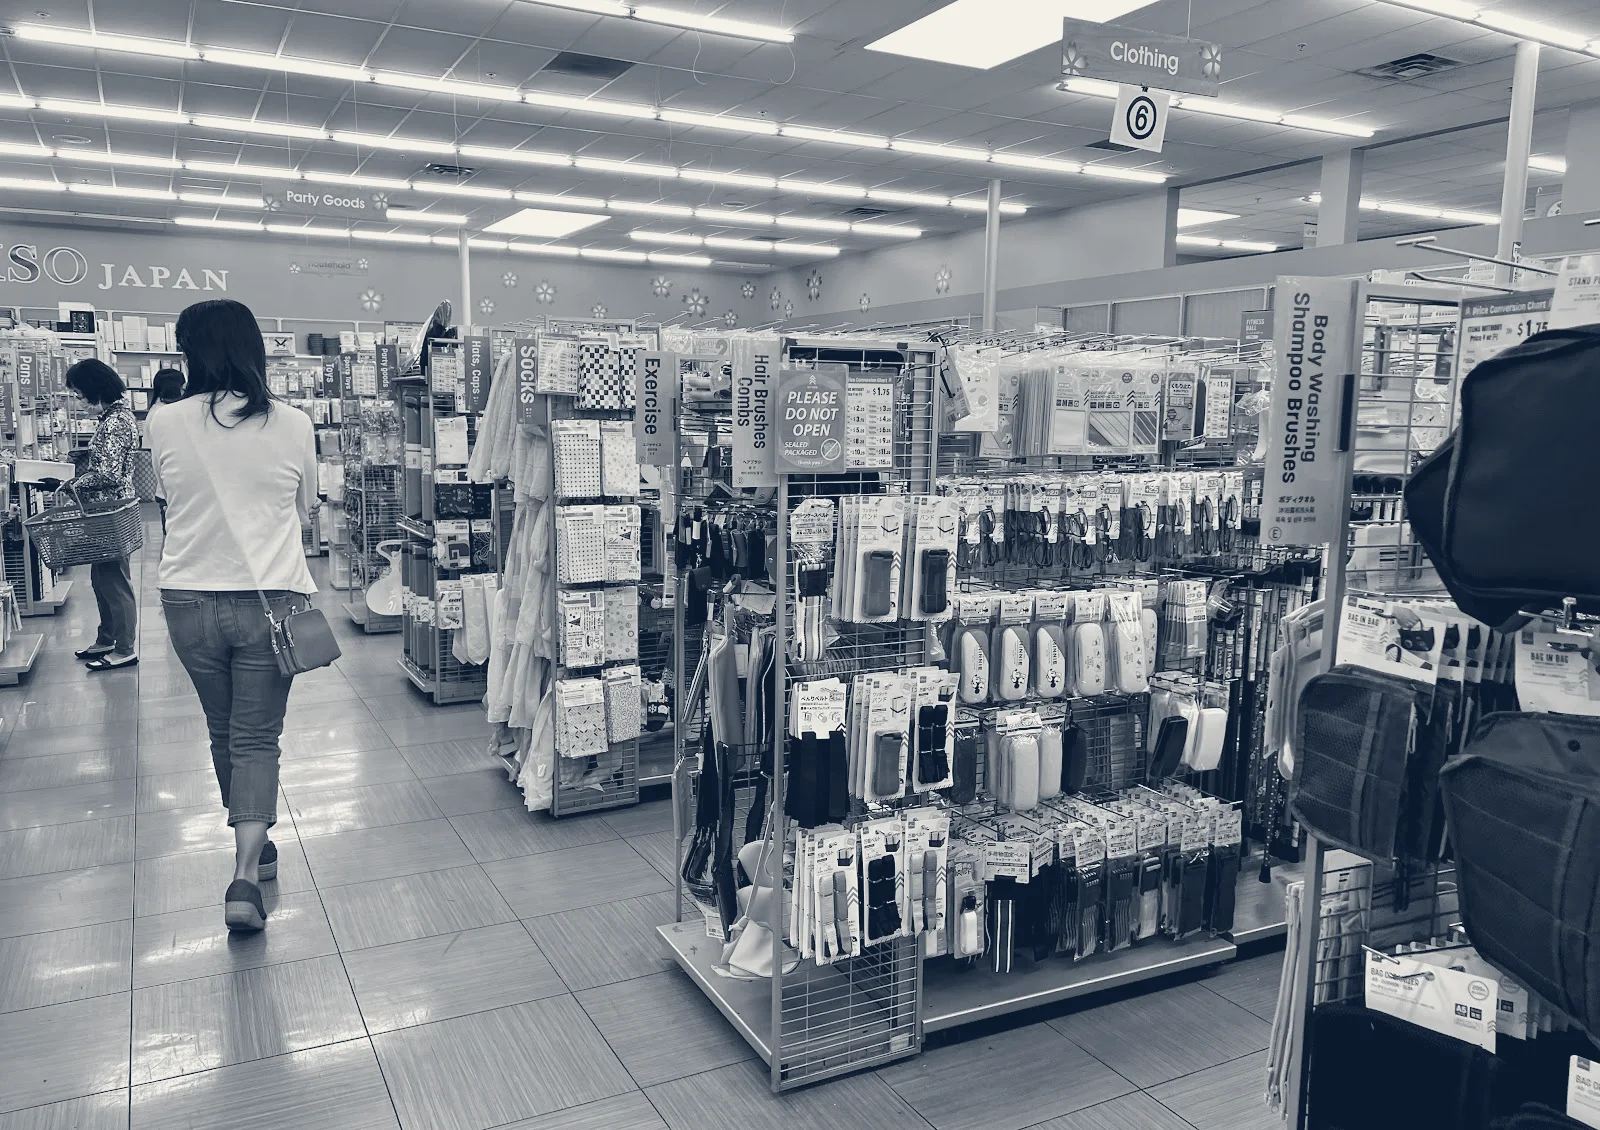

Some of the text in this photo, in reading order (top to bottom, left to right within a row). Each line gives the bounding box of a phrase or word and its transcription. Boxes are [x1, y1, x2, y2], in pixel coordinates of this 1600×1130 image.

[1110, 41, 1179, 76] Clothing
[1135, 105, 1149, 131] 6
[286, 190, 366, 209] Party Goods
[0, 244, 229, 291] SO JAPAN
[1472, 306, 1488, 316] Price
[1490, 302, 1526, 313] Conversion
[1286, 292, 1310, 391] Shampoo
[20, 356, 32, 385] Pans
[325, 363, 335, 383] Toys
[380, 348, 389, 388] Party goods
[470, 341, 481, 394] Hats, Caps
[344, 376, 352, 390] Toys
[1301, 315, 1328, 462] Body Washing
[645, 359, 661, 435] Exercise
[737, 377, 753, 427] Combs
[754, 355, 769, 449] Hair Brushes
[787, 391, 837, 404] PLEASE
[785, 408, 839, 420] DO NOT
[793, 424, 831, 436] OPEN
[1282, 398, 1302, 483] Brushes
[1348, 612, 1358, 621] BAG
[1368, 617, 1380, 626] BAG
[1531, 652, 1569, 664] BAG IN BAG
[1371, 968, 1384, 978] BAG
[1576, 1075, 1591, 1087] BAG
